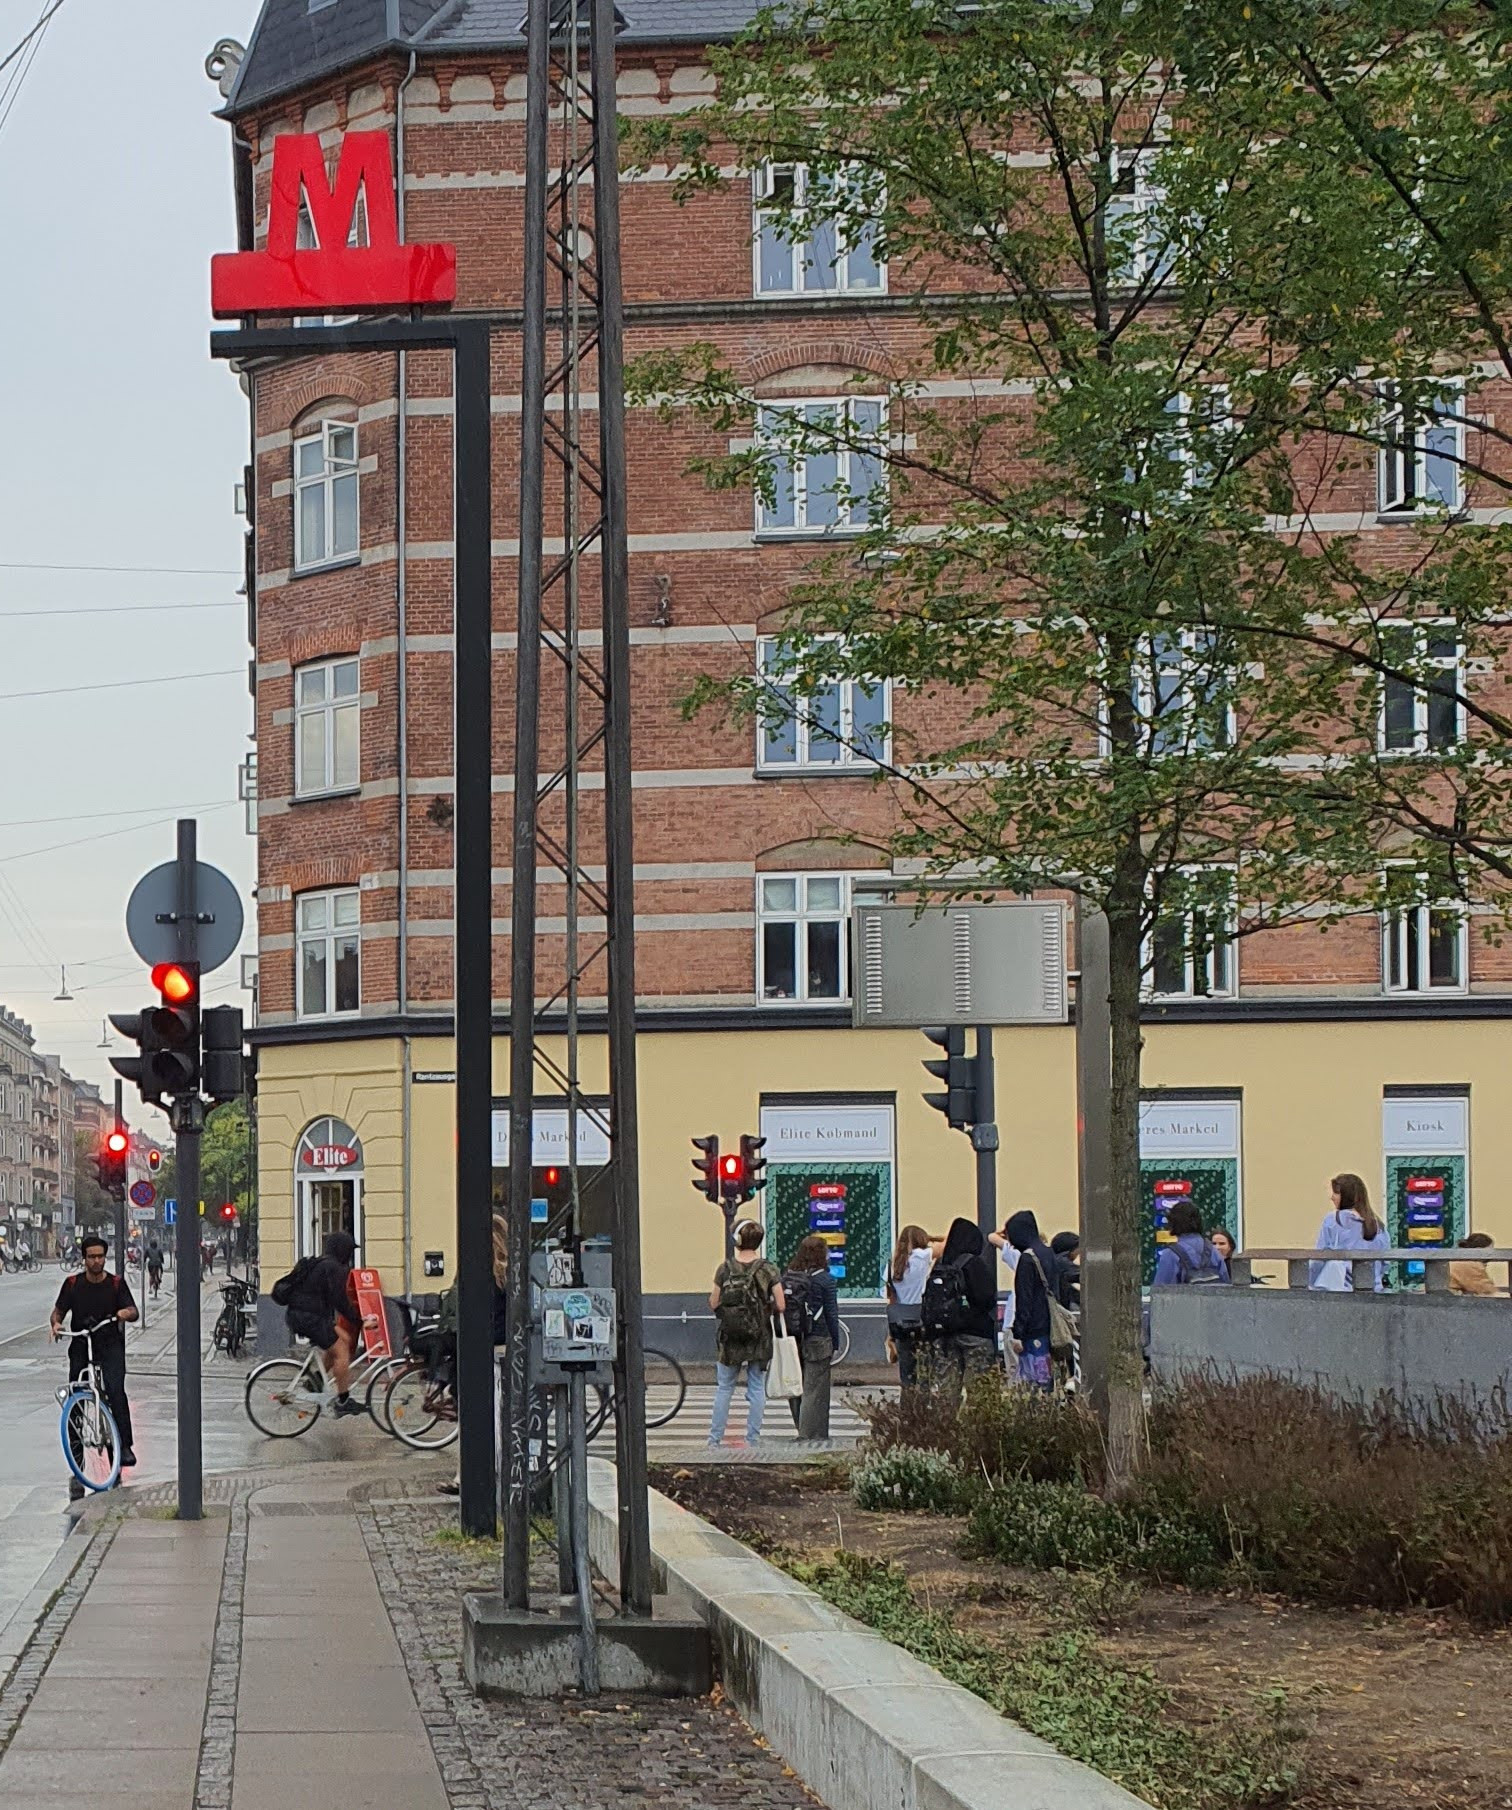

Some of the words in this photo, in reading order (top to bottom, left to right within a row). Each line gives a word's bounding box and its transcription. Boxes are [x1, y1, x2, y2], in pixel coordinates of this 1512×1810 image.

[268, 131, 399, 252] M
[1169, 1123, 1219, 1134] Marked
[1406, 1120, 1445, 1131] Kiosk
[539, 1131, 586, 1142] Markd
[780, 1127, 811, 1139] Elite
[313, 1147, 348, 1166] Elite
